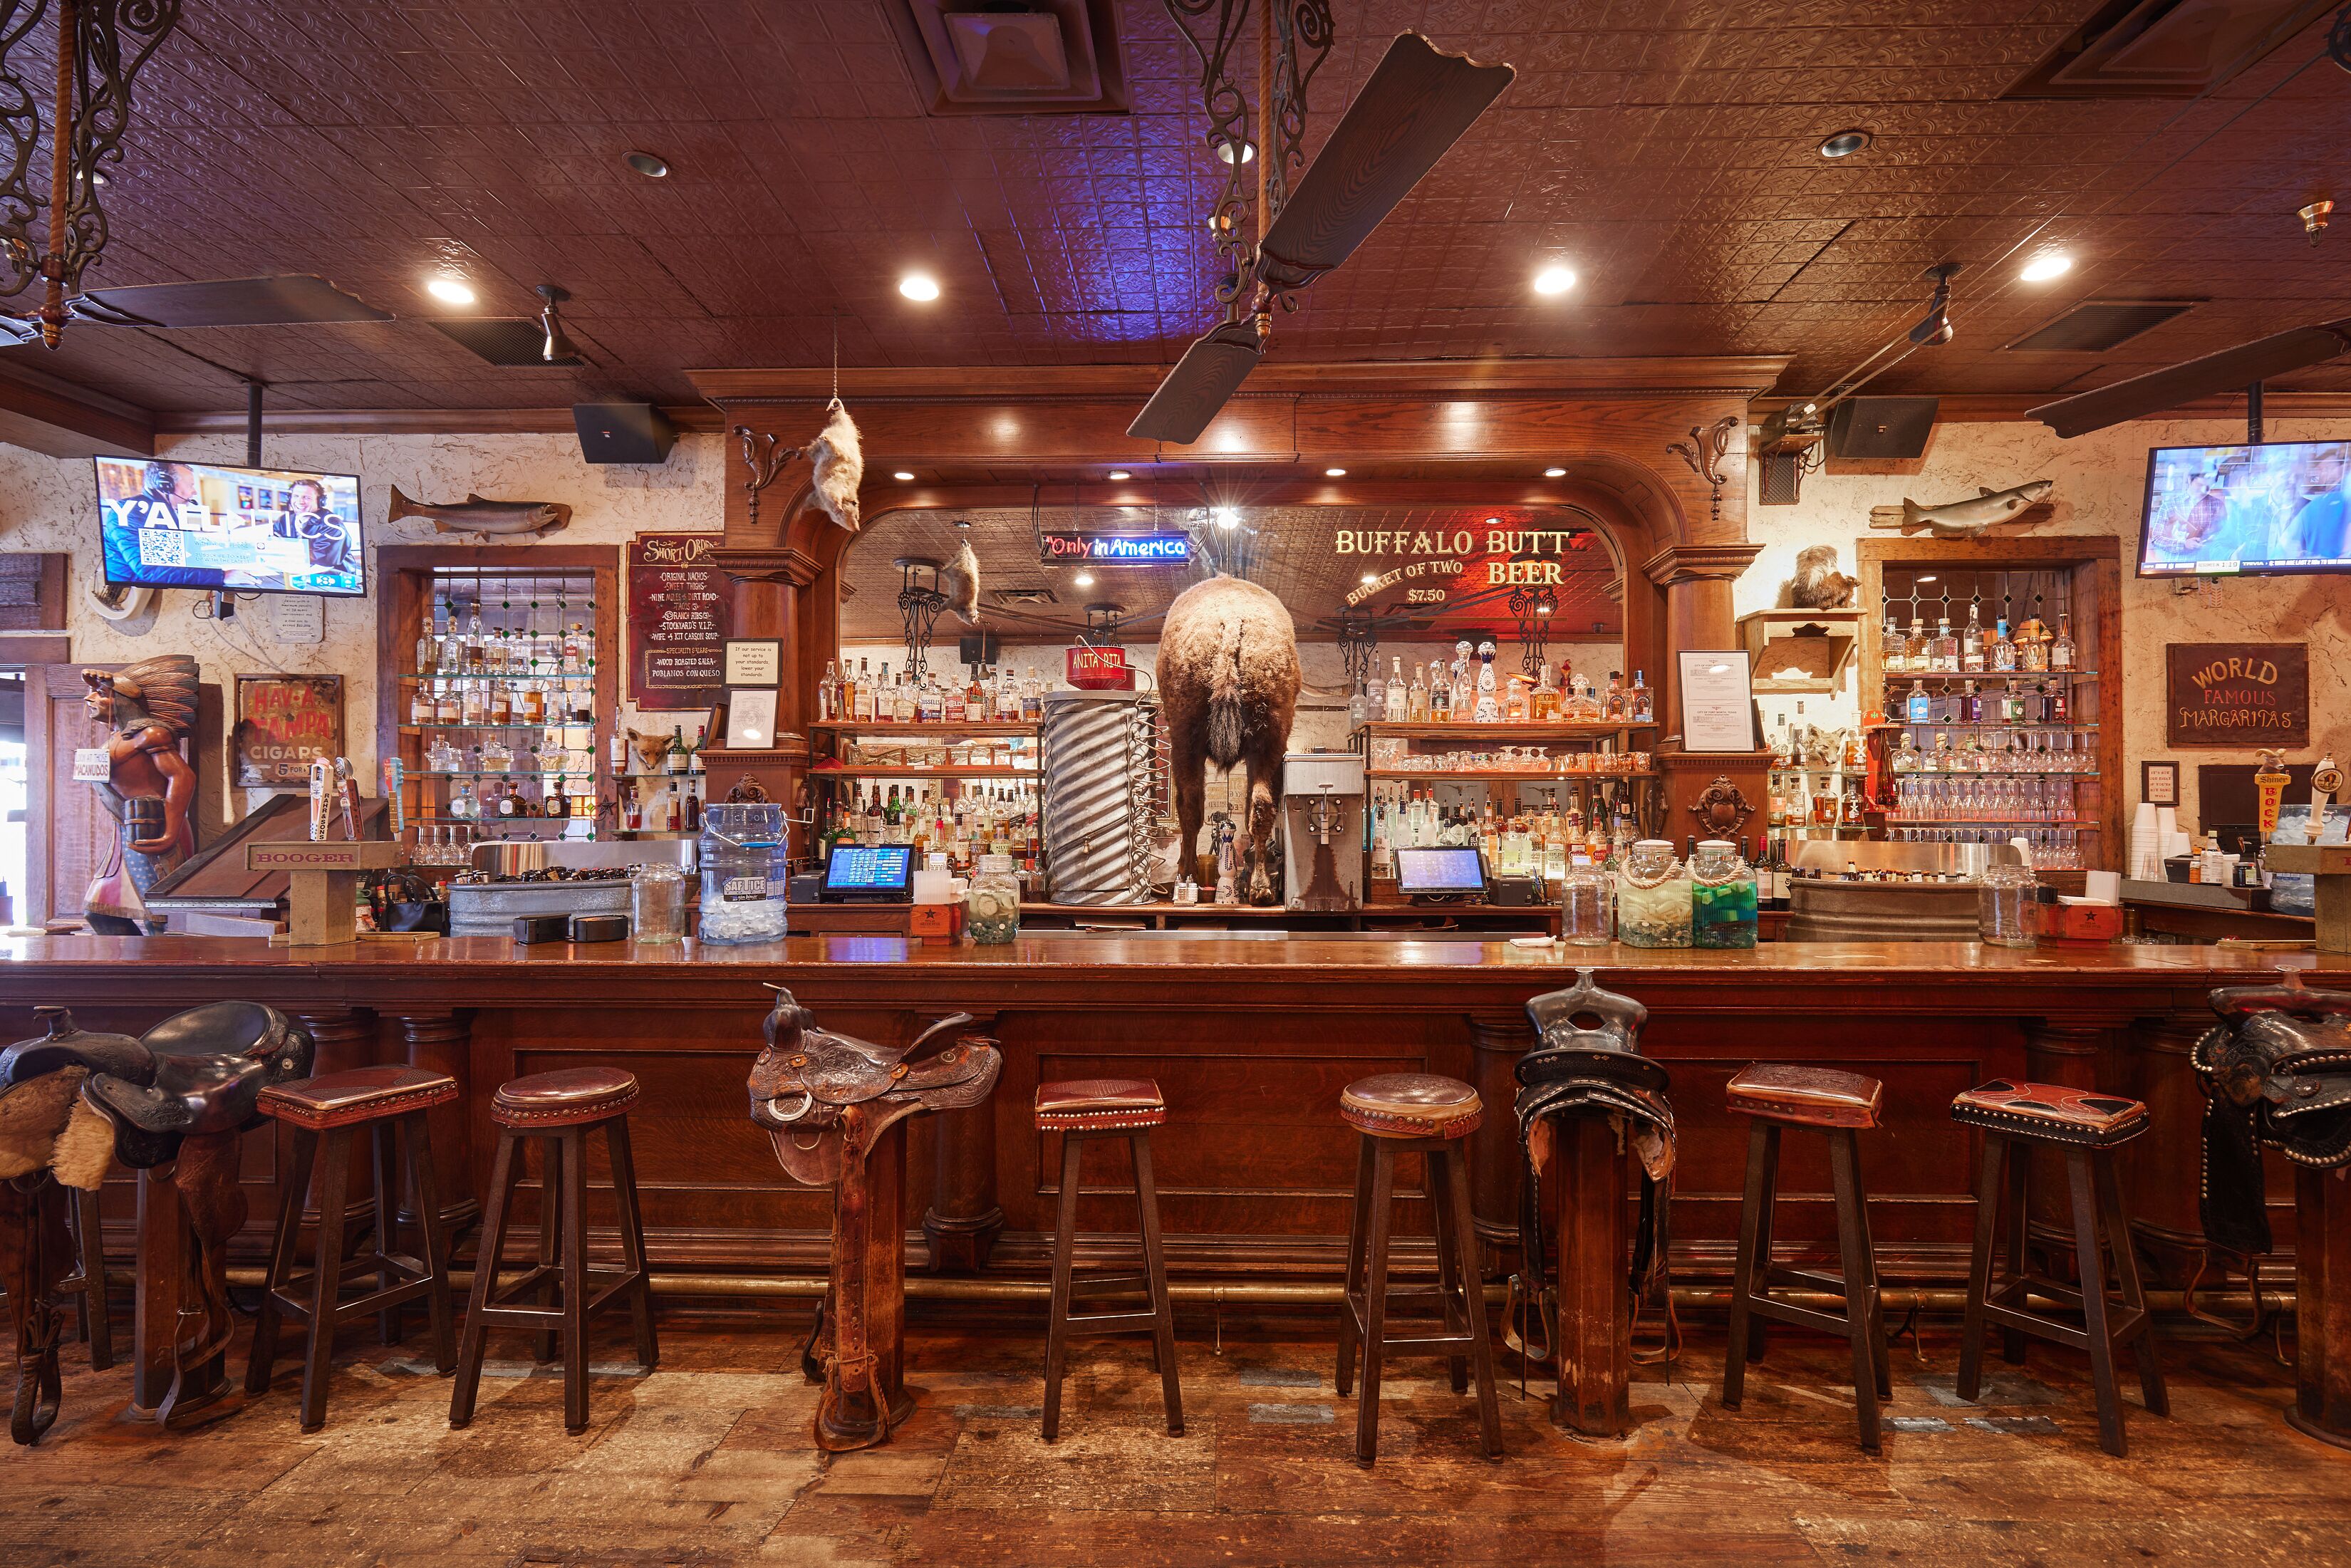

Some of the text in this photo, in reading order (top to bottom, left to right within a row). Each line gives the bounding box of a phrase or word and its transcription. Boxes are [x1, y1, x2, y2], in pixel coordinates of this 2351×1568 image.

[1094, 539, 1108, 555] in
[1110, 539, 1185, 556] America
[1336, 530, 1569, 554] BUFFALO BUTT
[643, 539, 684, 563] SHORT
[661, 572, 707, 581] ORIGINAL NACHOS
[1487, 562, 1565, 585] BEER
[666, 582, 684, 591] SWEET
[1346, 559, 1463, 606] BUCKET OF TWO
[1408, 588, 1446, 604] $7.50
[662, 621, 697, 630] STOCKYARD'S
[1073, 653, 1121, 669] ANITA RITA
[700, 669, 720, 677] QUESO
[2191, 658, 2278, 690] WORLD
[2204, 690, 2276, 706] FAMOUS
[2180, 707, 2292, 728] MARGARITAS
[248, 711, 331, 744] TAMPA
[250, 746, 323, 759] CIGARS
[74, 764, 108, 777] MACANUDOS
[279, 763, 289, 776] 5
[2259, 775, 2288, 784] Shiner
[2263, 787, 2278, 829] BOCK
[256, 853, 354, 863] BOOGER
